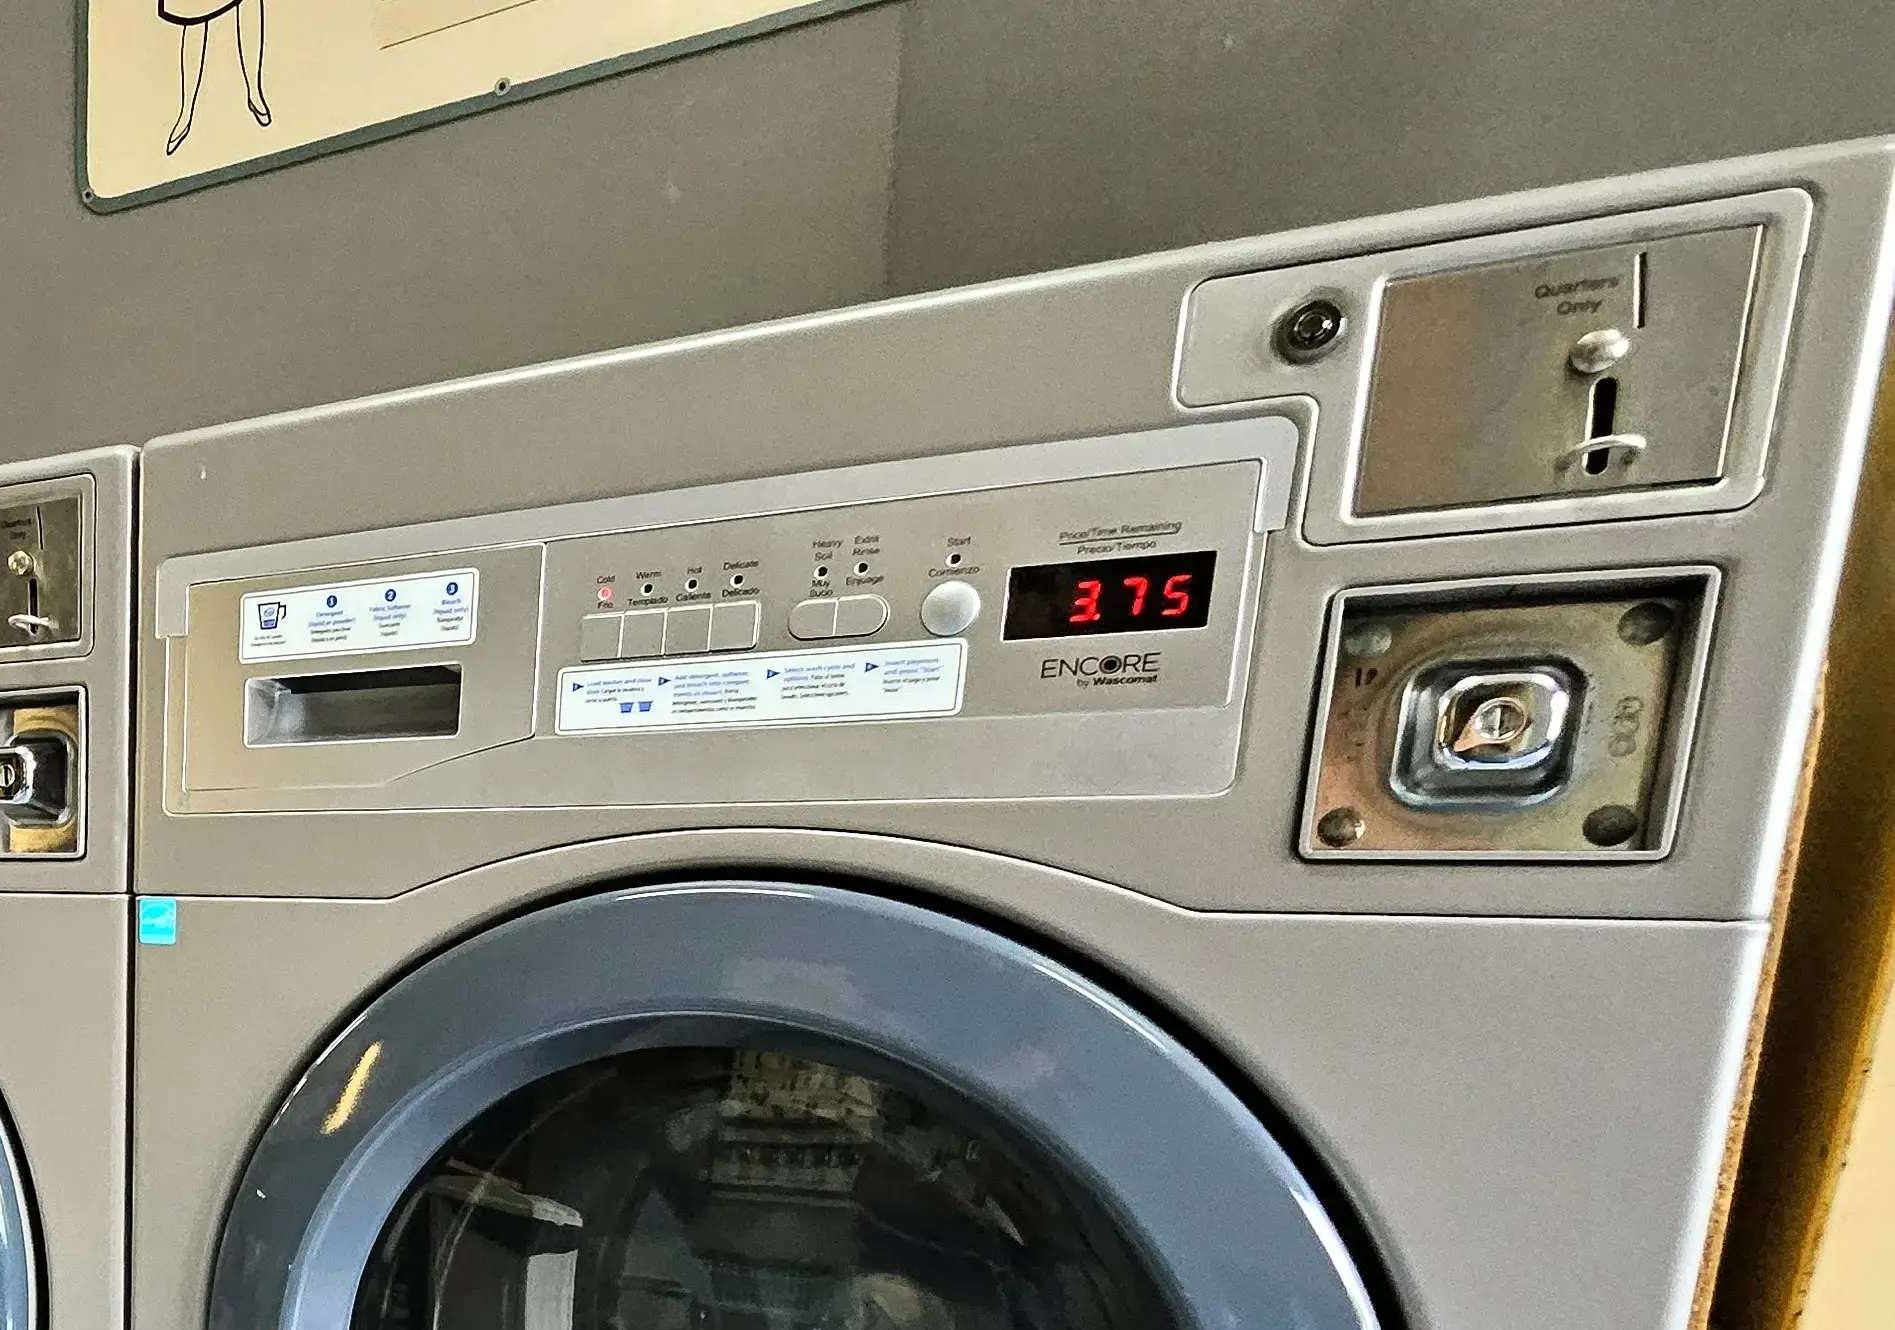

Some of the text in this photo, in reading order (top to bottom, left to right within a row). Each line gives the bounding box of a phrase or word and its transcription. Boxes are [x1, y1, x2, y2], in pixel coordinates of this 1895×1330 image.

[1534, 276, 1620, 299] Quarters
[1557, 300, 1603, 314] Only
[1059, 520, 1183, 541] Price/Time Remaining
[947, 536, 972, 548] Start
[687, 566, 703, 575] Hot
[723, 559, 759, 571] Delicate
[635, 570, 662, 580] Warm
[928, 566, 981, 578] Comienzo
[596, 575, 616, 585] Cold
[675, 591, 712, 602] Caliente
[1040, 651, 1162, 679] ENCORE
[1077, 675, 1157, 687] by Wascomat
